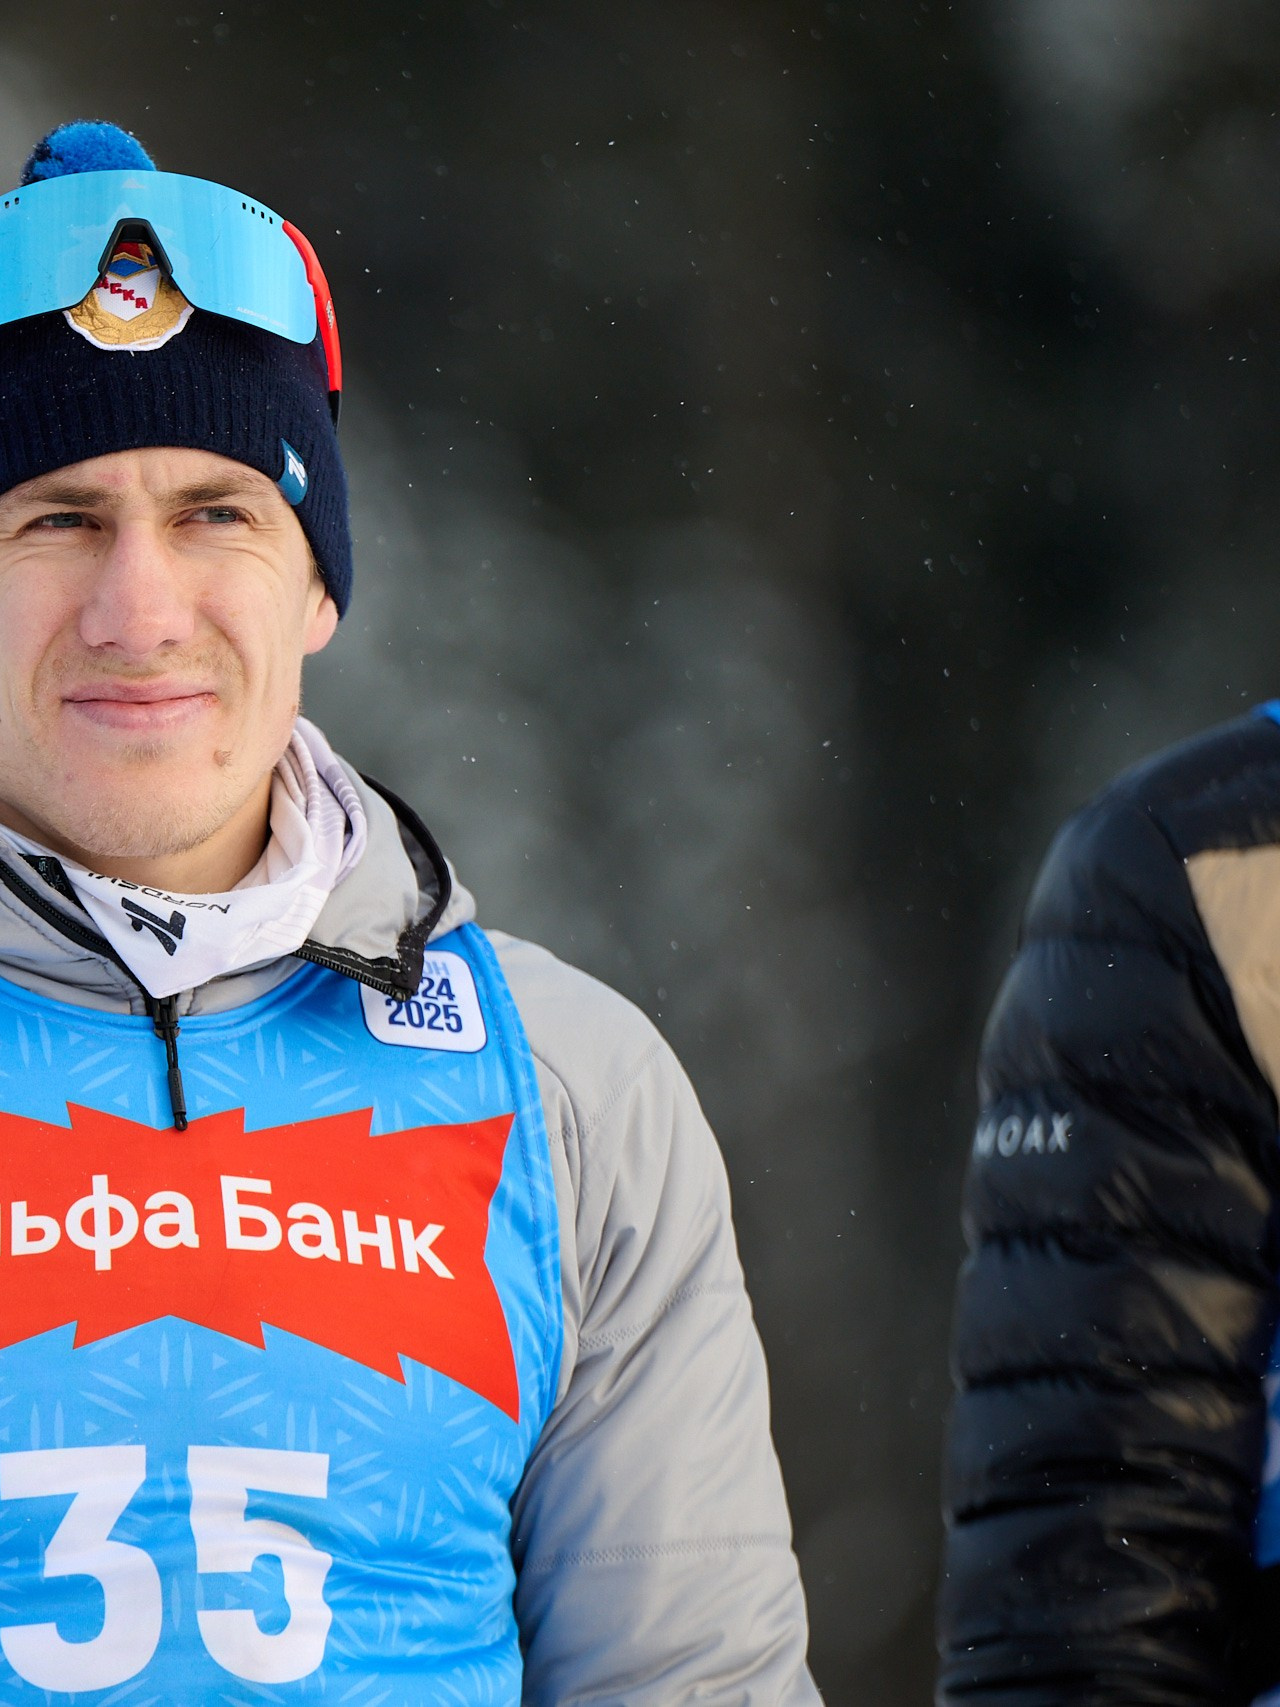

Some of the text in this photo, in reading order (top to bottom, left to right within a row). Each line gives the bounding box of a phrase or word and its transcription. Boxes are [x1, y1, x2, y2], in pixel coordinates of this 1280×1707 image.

[87, 871, 231, 914] NORDS
[413, 976, 456, 1001] 24
[385, 998, 463, 1034] 2025
[220, 1174, 456, 1281] Банк
